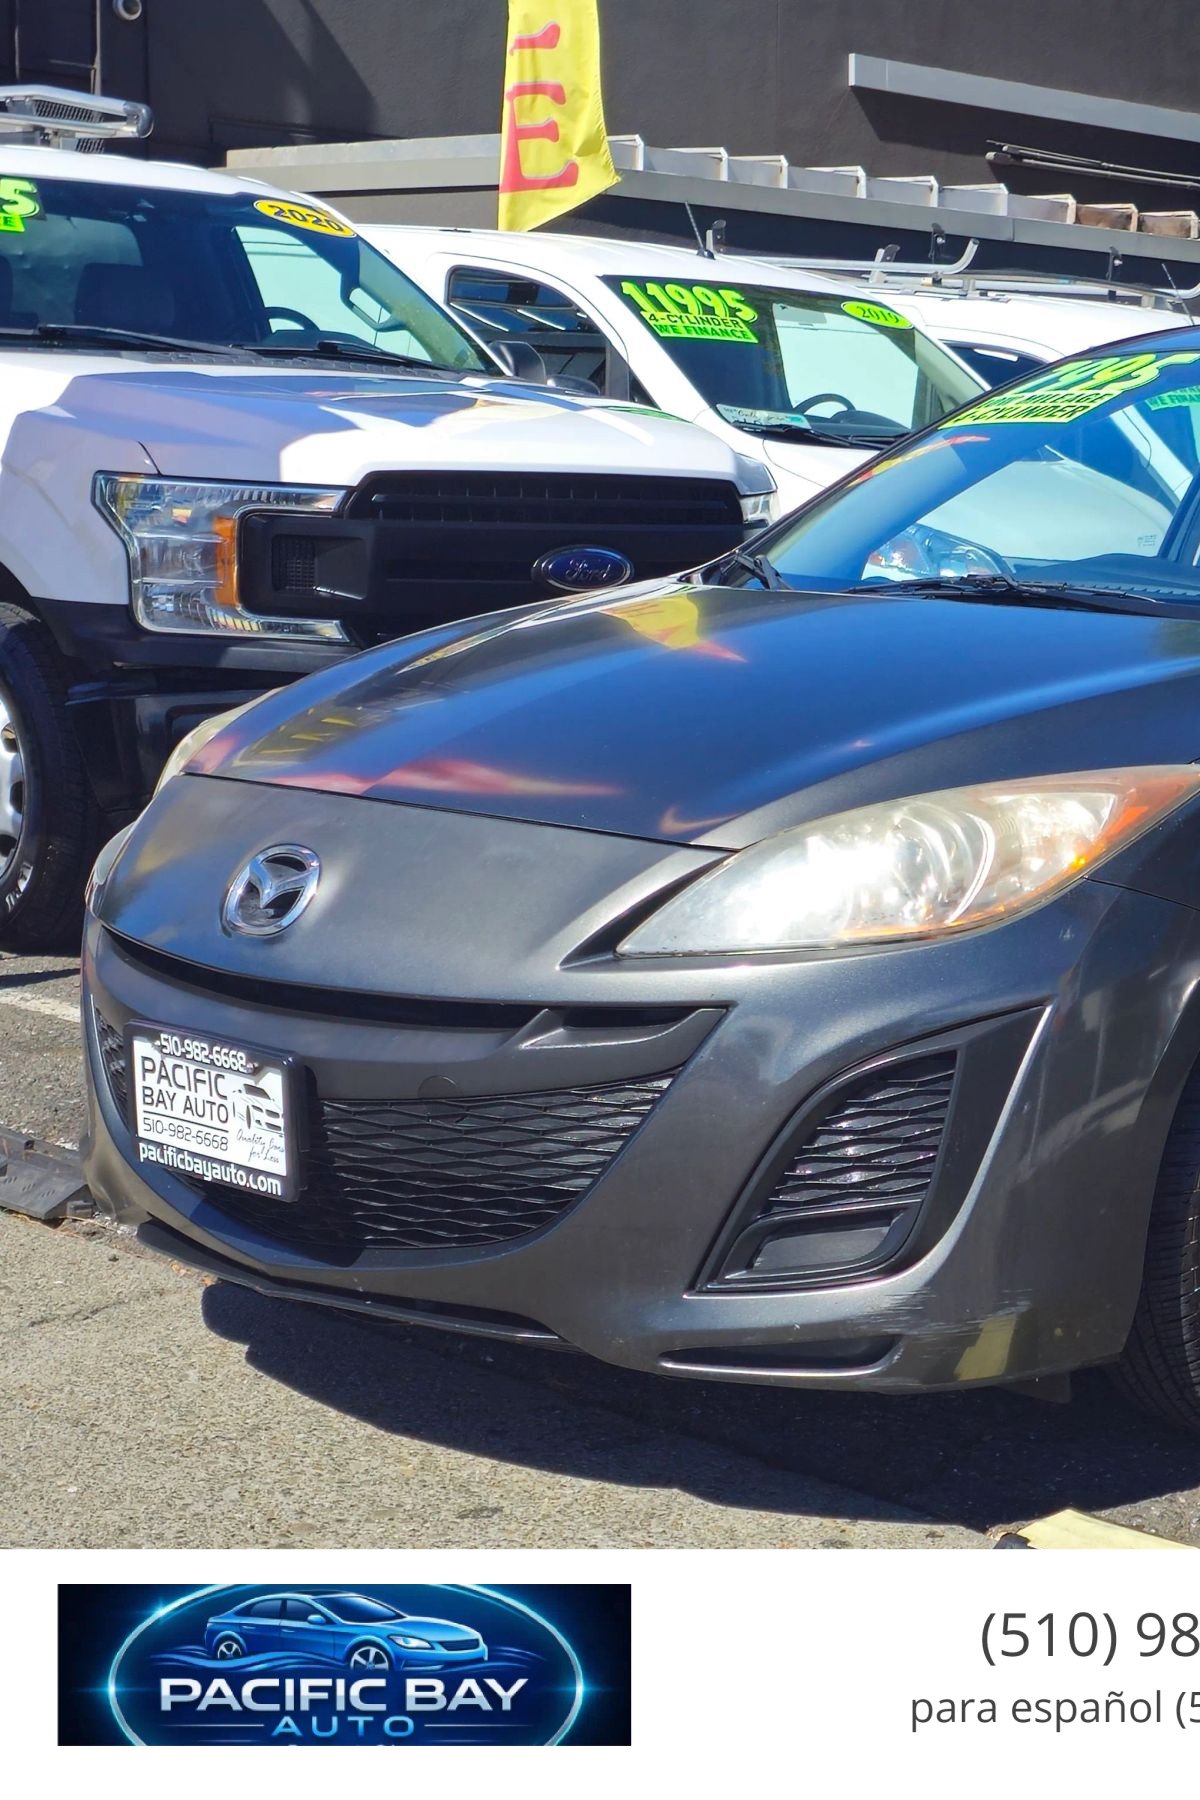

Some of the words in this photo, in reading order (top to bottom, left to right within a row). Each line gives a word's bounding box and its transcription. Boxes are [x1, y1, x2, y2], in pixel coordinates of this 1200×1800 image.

[267, 205, 345, 232] 2020
[621, 281, 758, 323] 11995
[856, 305, 900, 324] 2019
[648, 313, 744, 329] 4-CYLINDER
[655, 323, 681, 334] WE
[685, 325, 750, 340] FINANCE
[1016, 392, 1115, 406] MILEAGE
[160, 1033, 248, 1074] 510-982-6668
[141, 1056, 228, 1101] PACIFIC
[142, 1086, 176, 1112] BAY
[183, 1095, 229, 1125] AUTO
[143, 1118, 229, 1152] 510-982-6668
[139, 1142, 282, 1197] pacificbayauto.com
